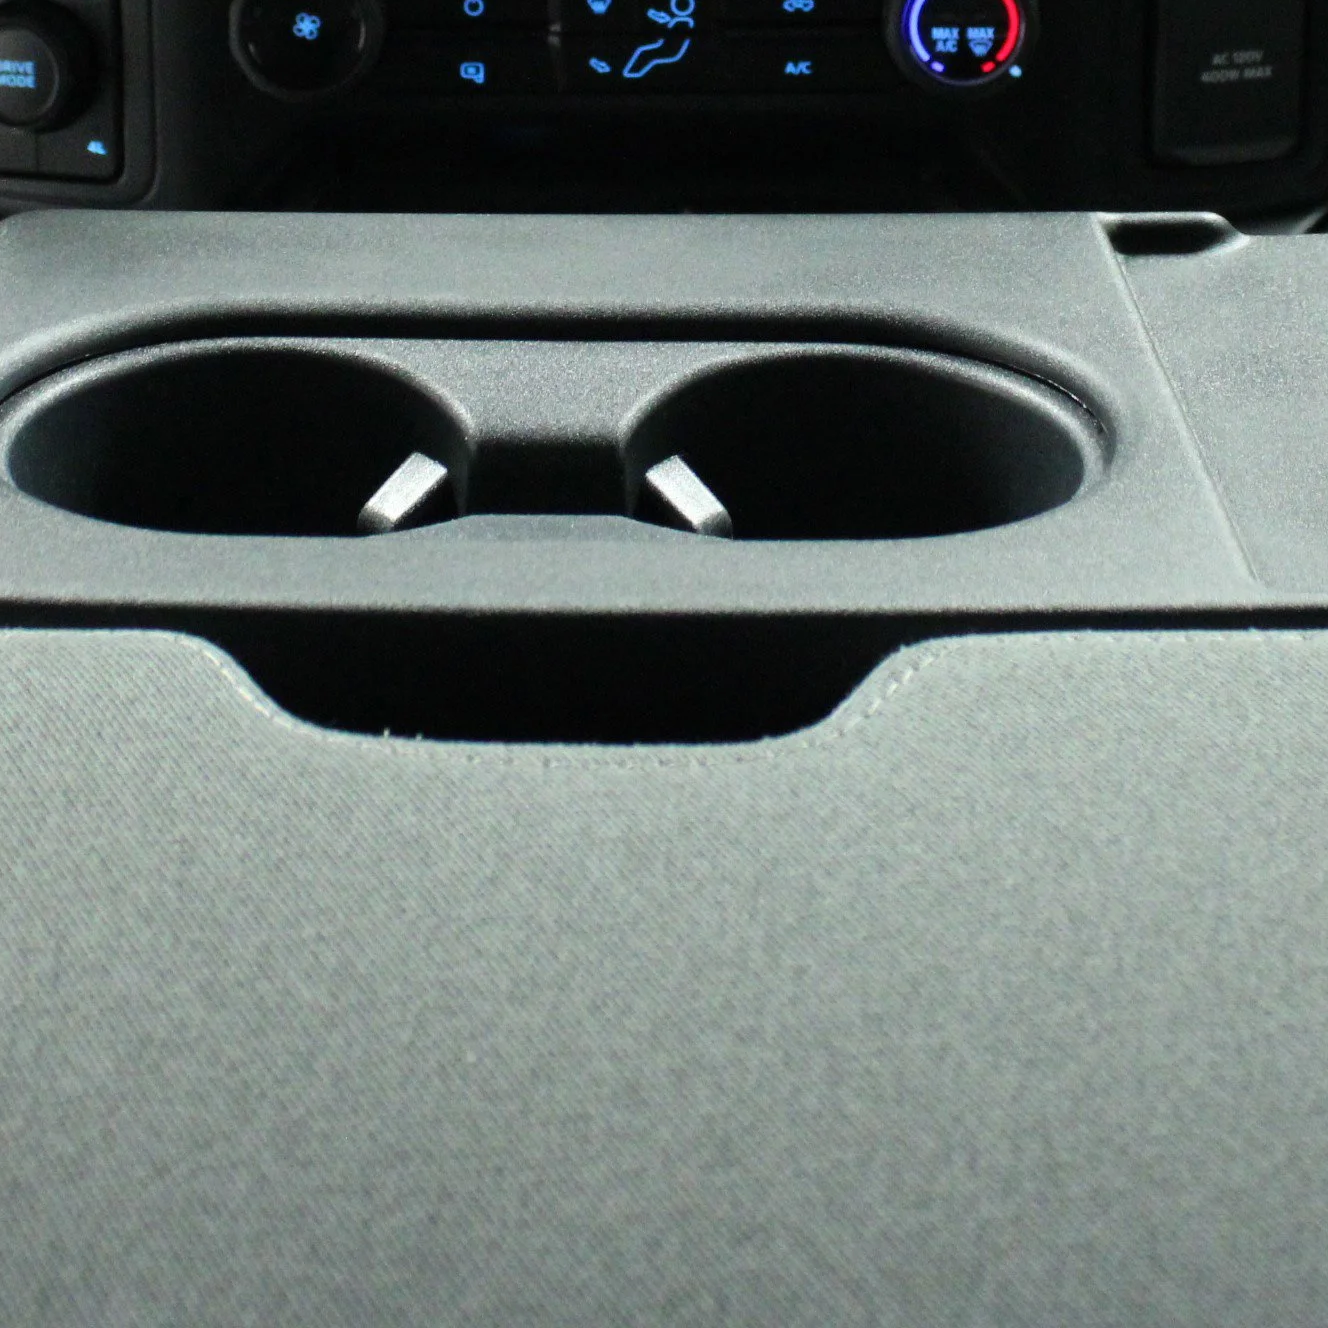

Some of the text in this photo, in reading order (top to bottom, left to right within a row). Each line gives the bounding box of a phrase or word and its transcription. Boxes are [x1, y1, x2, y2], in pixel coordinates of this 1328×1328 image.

[931, 27, 960, 40] MAX
[966, 27, 995, 40] MAX
[935, 40, 958, 52] A/C
[784, 60, 812, 75] A/C
